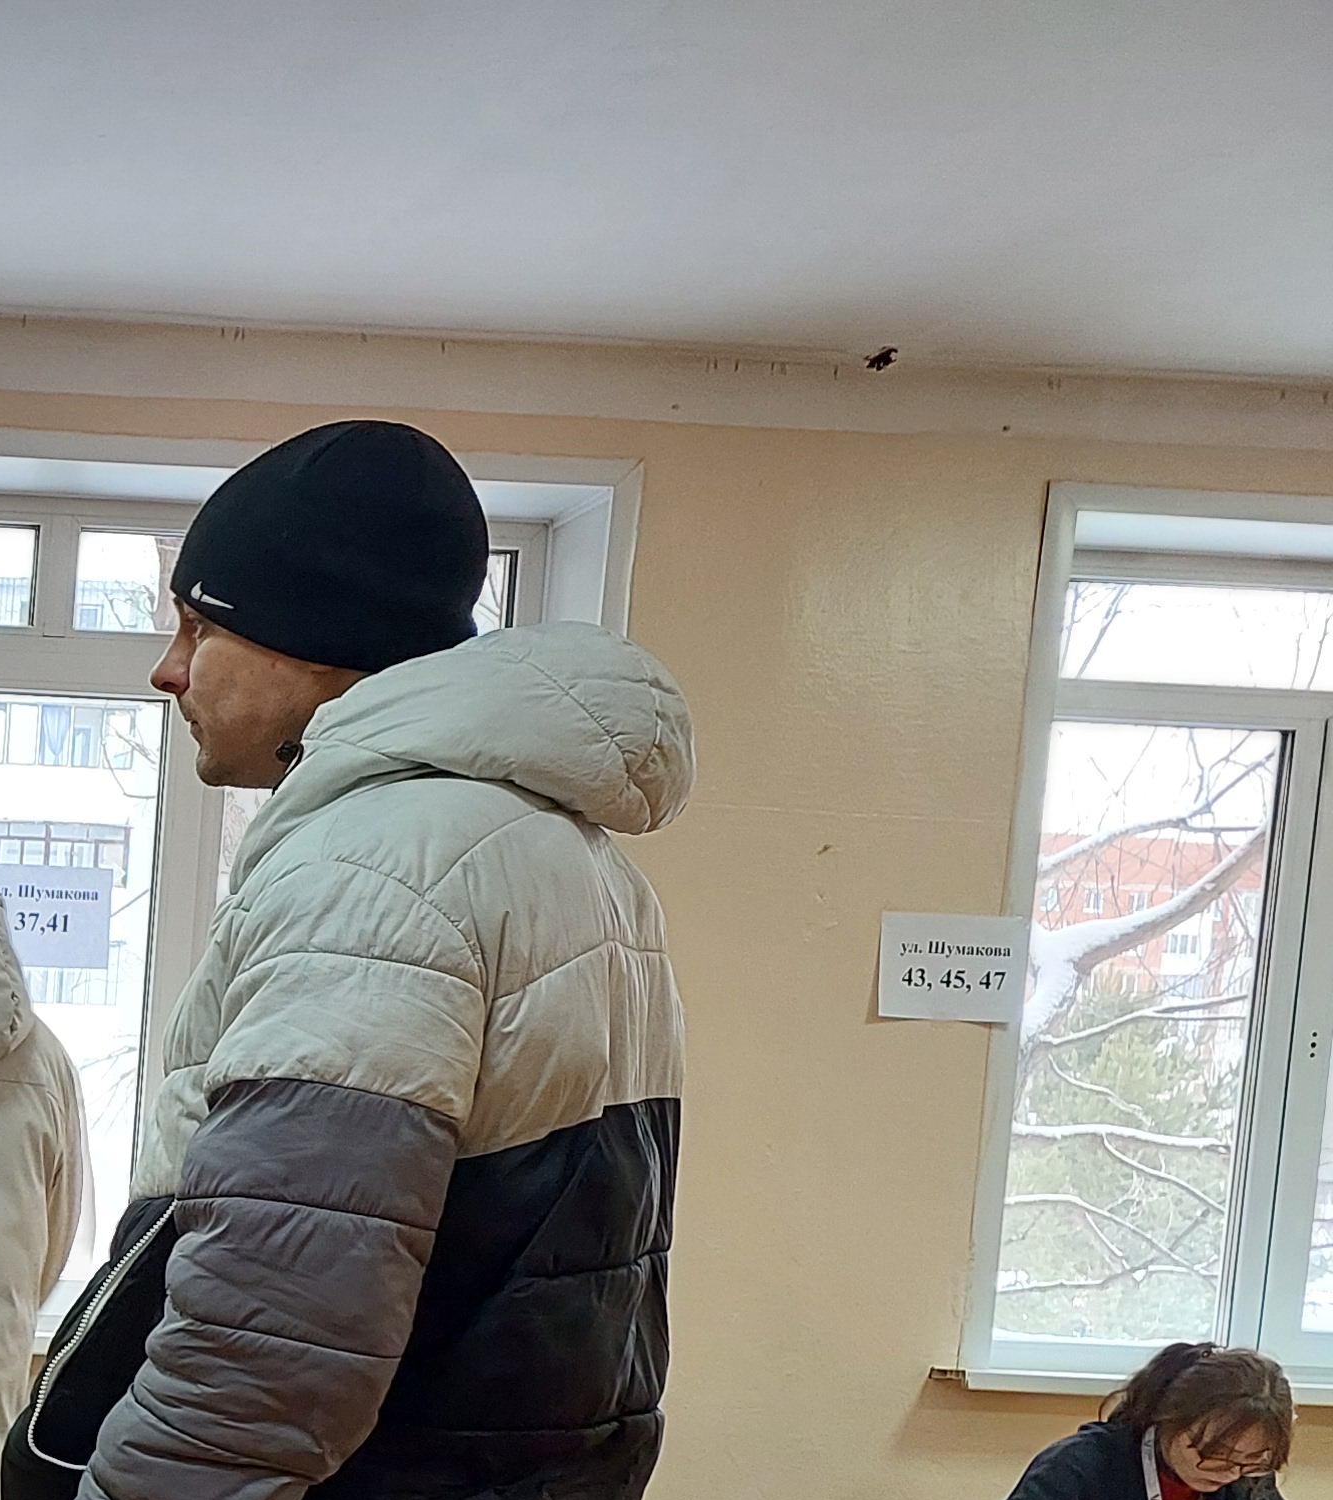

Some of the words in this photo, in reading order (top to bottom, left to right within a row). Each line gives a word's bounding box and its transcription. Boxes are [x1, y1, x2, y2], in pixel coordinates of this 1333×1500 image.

[18, 884, 99, 902] Шумакова
[14, 911, 70, 936] 37,41
[899, 942, 923, 957] ул.
[927, 940, 1012, 959] Шумакова
[901, 967, 933, 992] 43,
[939, 969, 972, 993] 45,
[978, 970, 1007, 991] 47
